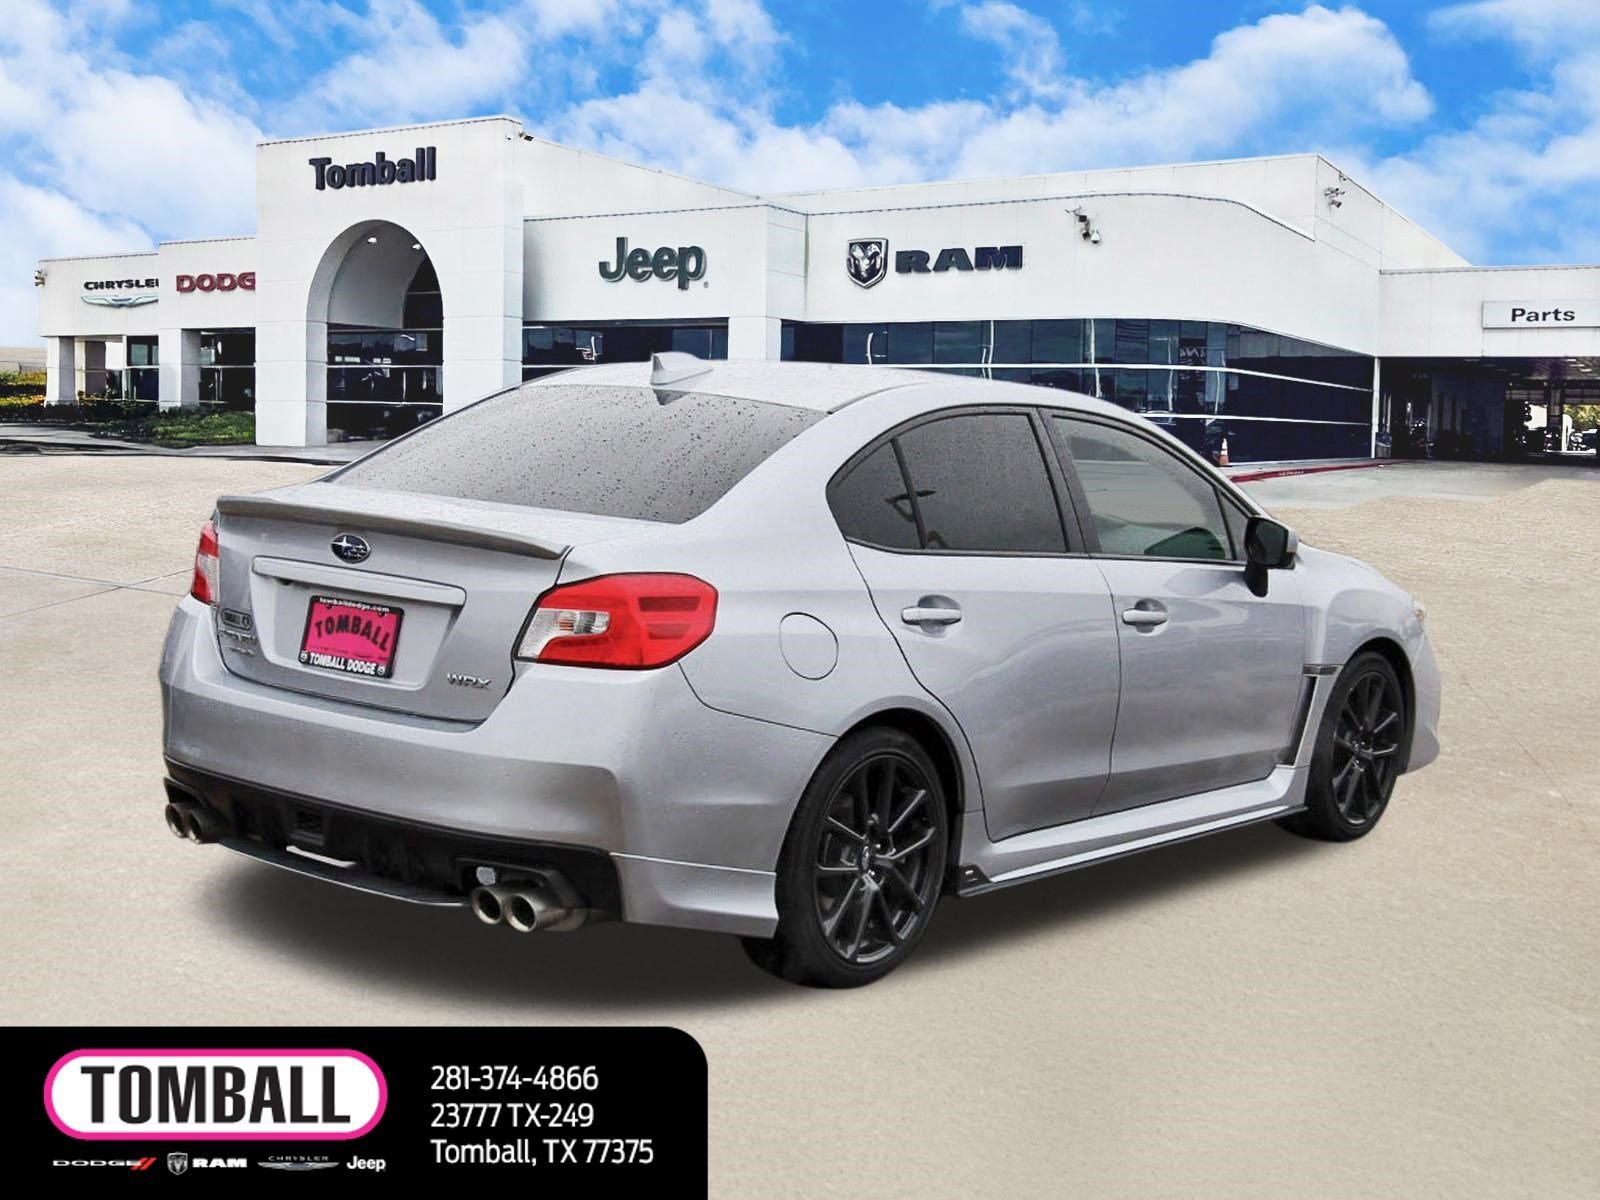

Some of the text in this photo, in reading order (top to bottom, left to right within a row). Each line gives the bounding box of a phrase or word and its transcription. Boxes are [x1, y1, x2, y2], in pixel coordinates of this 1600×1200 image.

[308, 146, 437, 191] Tomball
[599, 236, 707, 291] Jeep
[895, 245, 1023, 274] RAM
[83, 277, 160, 291] CHRYSLE
[1511, 307, 1576, 322] Parts
[315, 613, 390, 652] TOMBALL
[309, 652, 378, 675] TOMBALL DODGE
[447, 673, 492, 690] WRX
